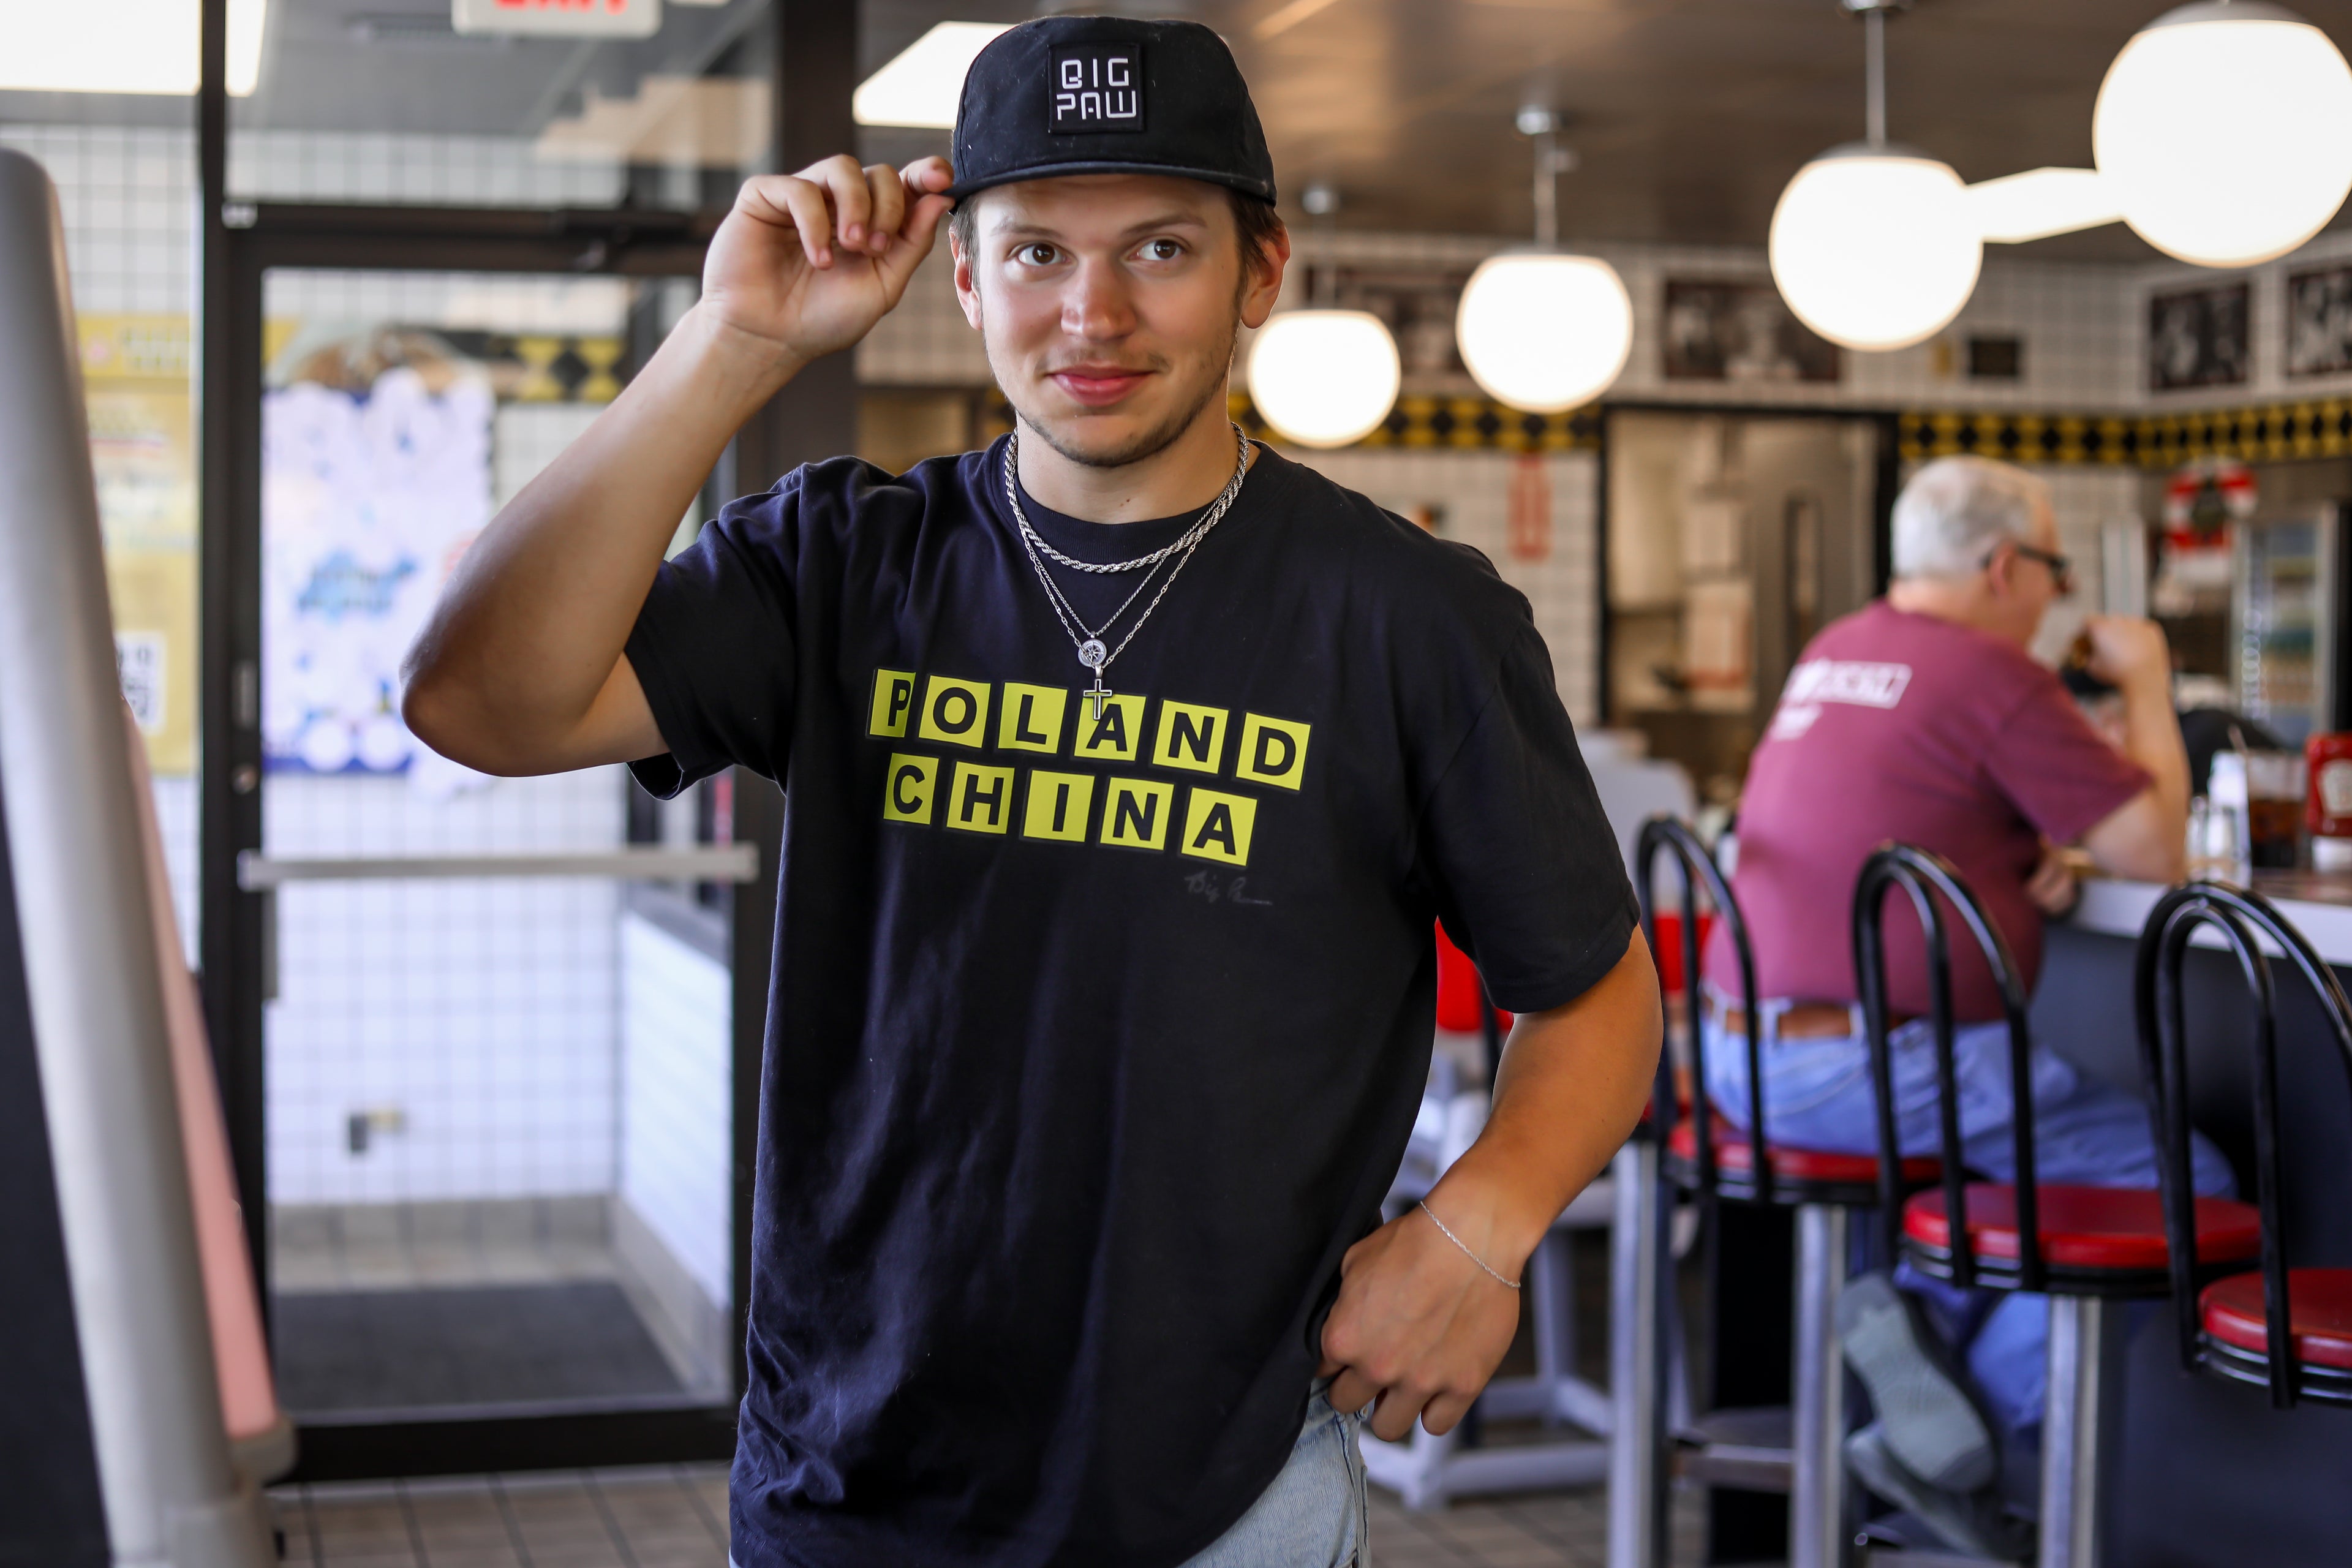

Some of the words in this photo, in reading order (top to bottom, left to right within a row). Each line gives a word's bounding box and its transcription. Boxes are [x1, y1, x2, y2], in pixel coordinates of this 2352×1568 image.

[1056, 91, 1137, 121] PAW
[887, 679, 1297, 776] POLAND
[893, 764, 1237, 856] CHINA
